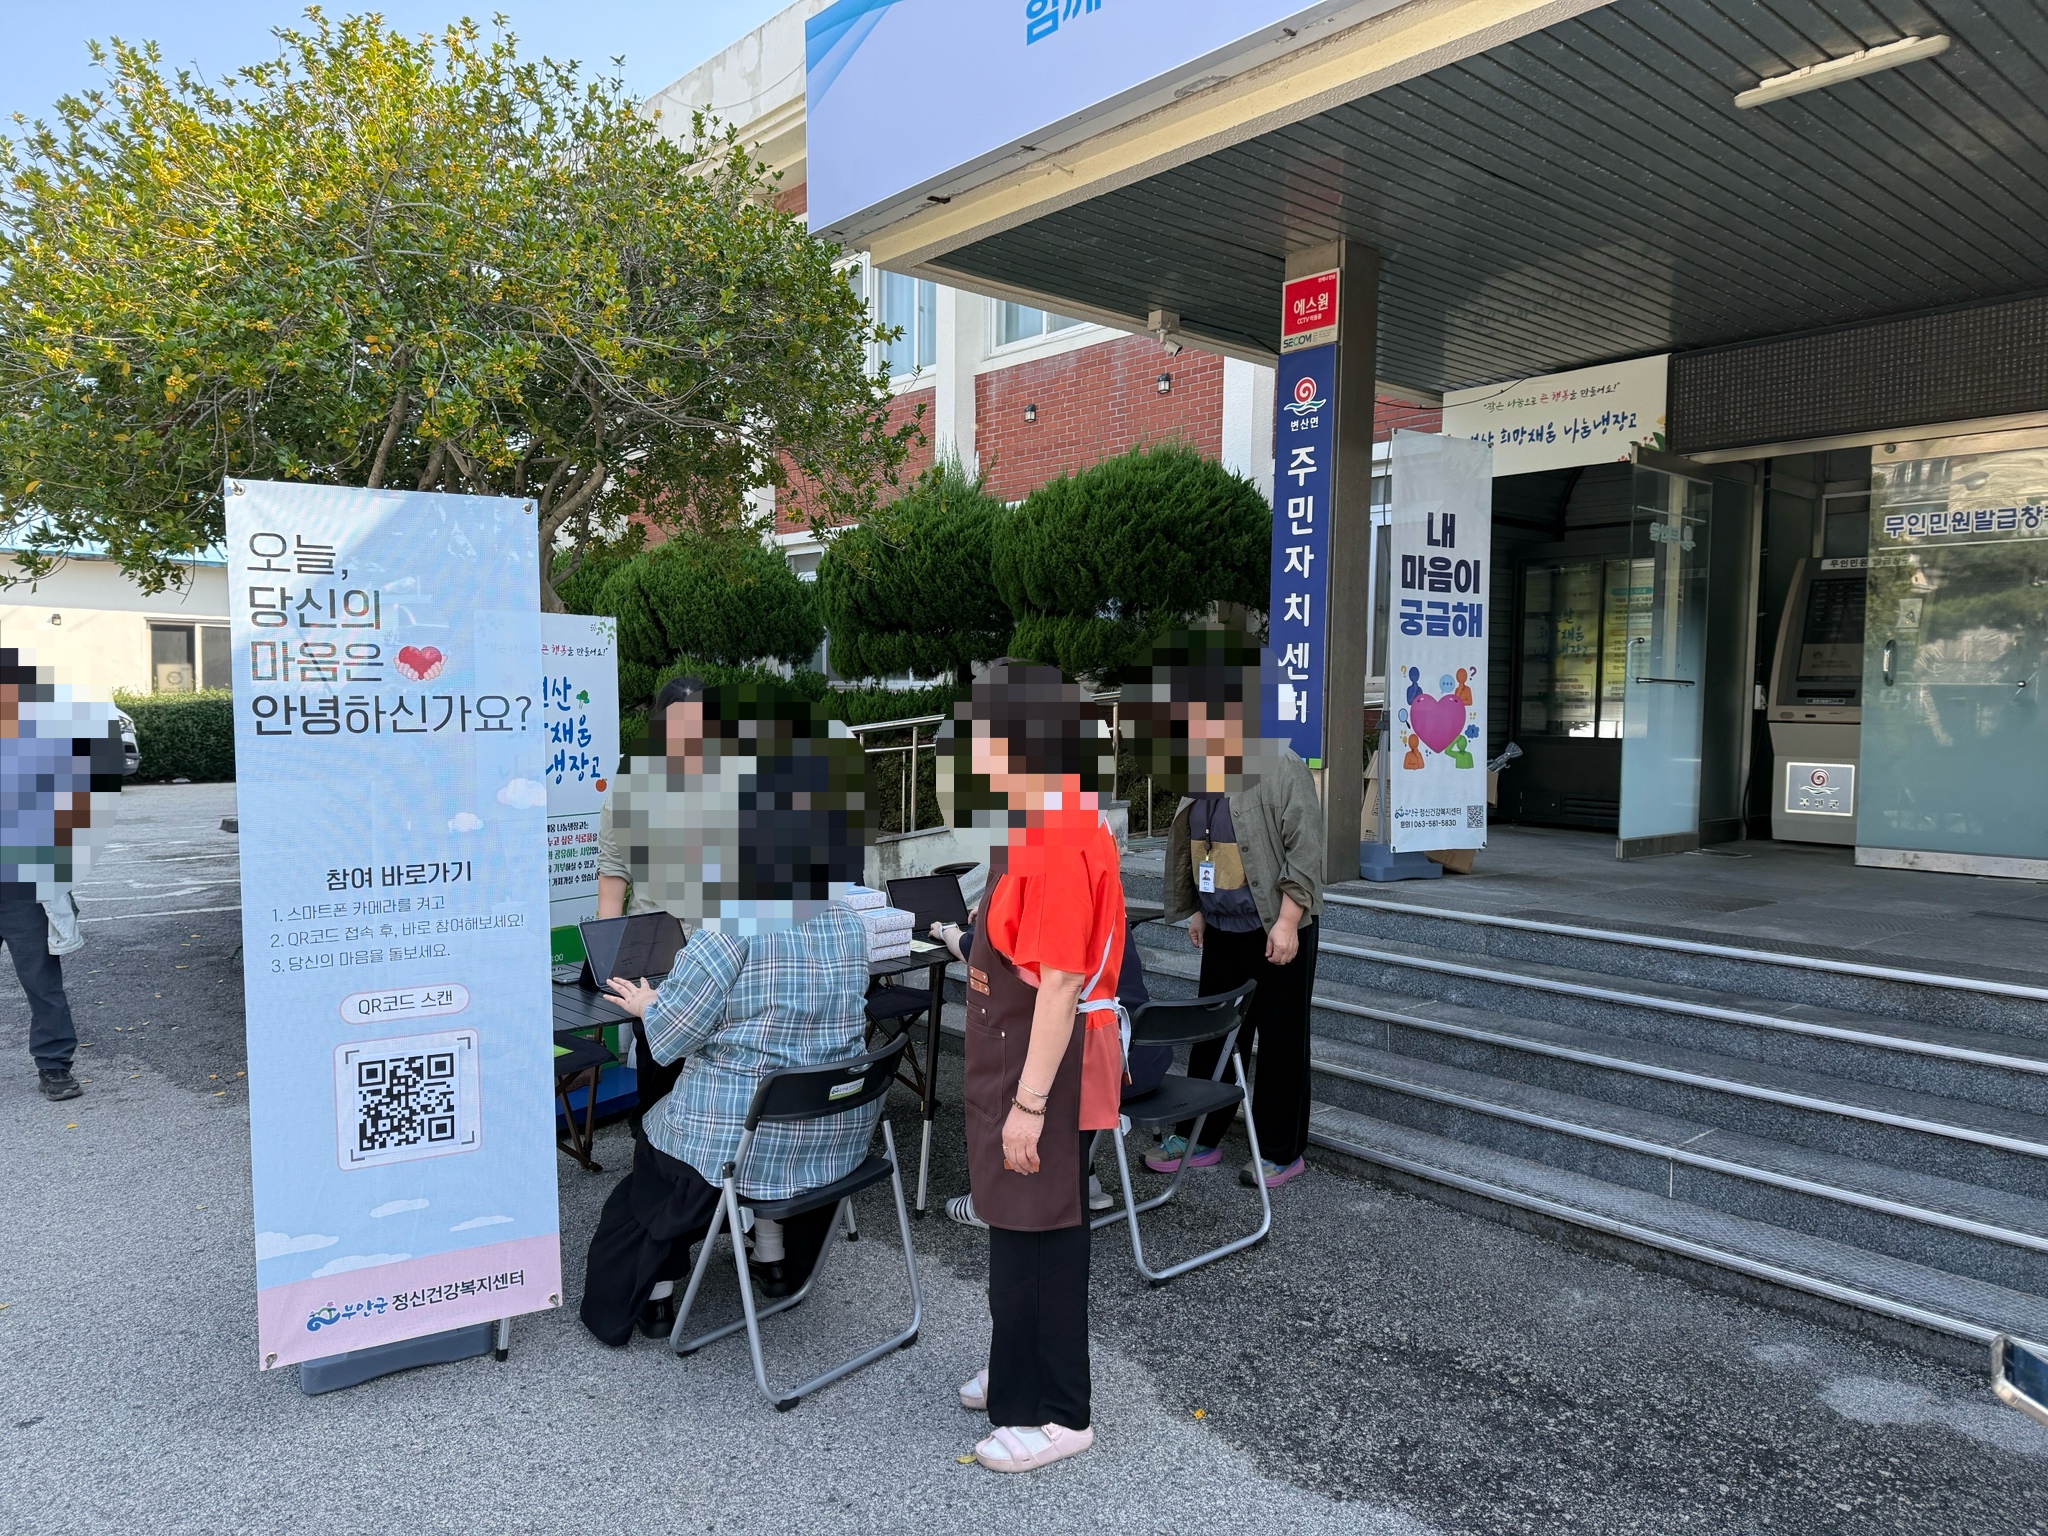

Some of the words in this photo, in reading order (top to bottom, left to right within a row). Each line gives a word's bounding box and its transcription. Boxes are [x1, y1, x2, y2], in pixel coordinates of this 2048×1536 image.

[1293, 292, 1329, 316] 에스원
[1297, 316, 1309, 325] CCTV
[1283, 334, 1312, 348] SECOM
[1507, 396, 1538, 408] 나눔으로
[1540, 392, 1549, 403] 큰
[1552, 389, 1577, 403] 행복을
[1290, 416, 1319, 432] 변산면
[1500, 421, 1557, 446] 희망채움
[1563, 410, 1637, 444] 나눔냉장고
[1426, 511, 1456, 549] 내
[246, 531, 348, 581] 오늘,
[1401, 553, 1481, 595] 마음이
[249, 586, 381, 631] 당신의
[1399, 598, 1483, 638] 궁금해
[250, 641, 384, 683] 마음은
[541, 644, 549, 656] 큰
[551, 644, 574, 657] 행복을
[251, 694, 532, 737] 안녕하신가요?
[1420, 807, 1462, 818] 정신건강복지센터
[561, 834, 573, 846] 싶은
[575, 832, 598, 844] 식료품을
[554, 848, 579, 860] 공유하는
[578, 861, 583, 870] 수
[326, 867, 373, 892] 참여
[381, 861, 472, 888] 바로가기
[272, 908, 284, 923] 1.
[287, 902, 348, 922] 스마트폰
[353, 898, 412, 917] 카메라를
[416, 896, 446, 912] 켜고
[270, 934, 285, 949] 2.
[287, 928, 340, 947] QR코드
[344, 925, 375, 942] 접속
[379, 923, 398, 940] 후,
[402, 920, 431, 938] 바로
[435, 913, 525, 935] 참여해보세요!
[271, 959, 285, 973] 3.
[288, 952, 334, 972] 당신의
[339, 949, 384, 967] 마음을
[388, 944, 451, 962] 돌보세요.
[358, 992, 415, 1016] QR코드
[421, 990, 454, 1009] 스캔
[341, 1296, 389, 1321] 부안군
[392, 1269, 525, 1312] 정신건강복지센터
